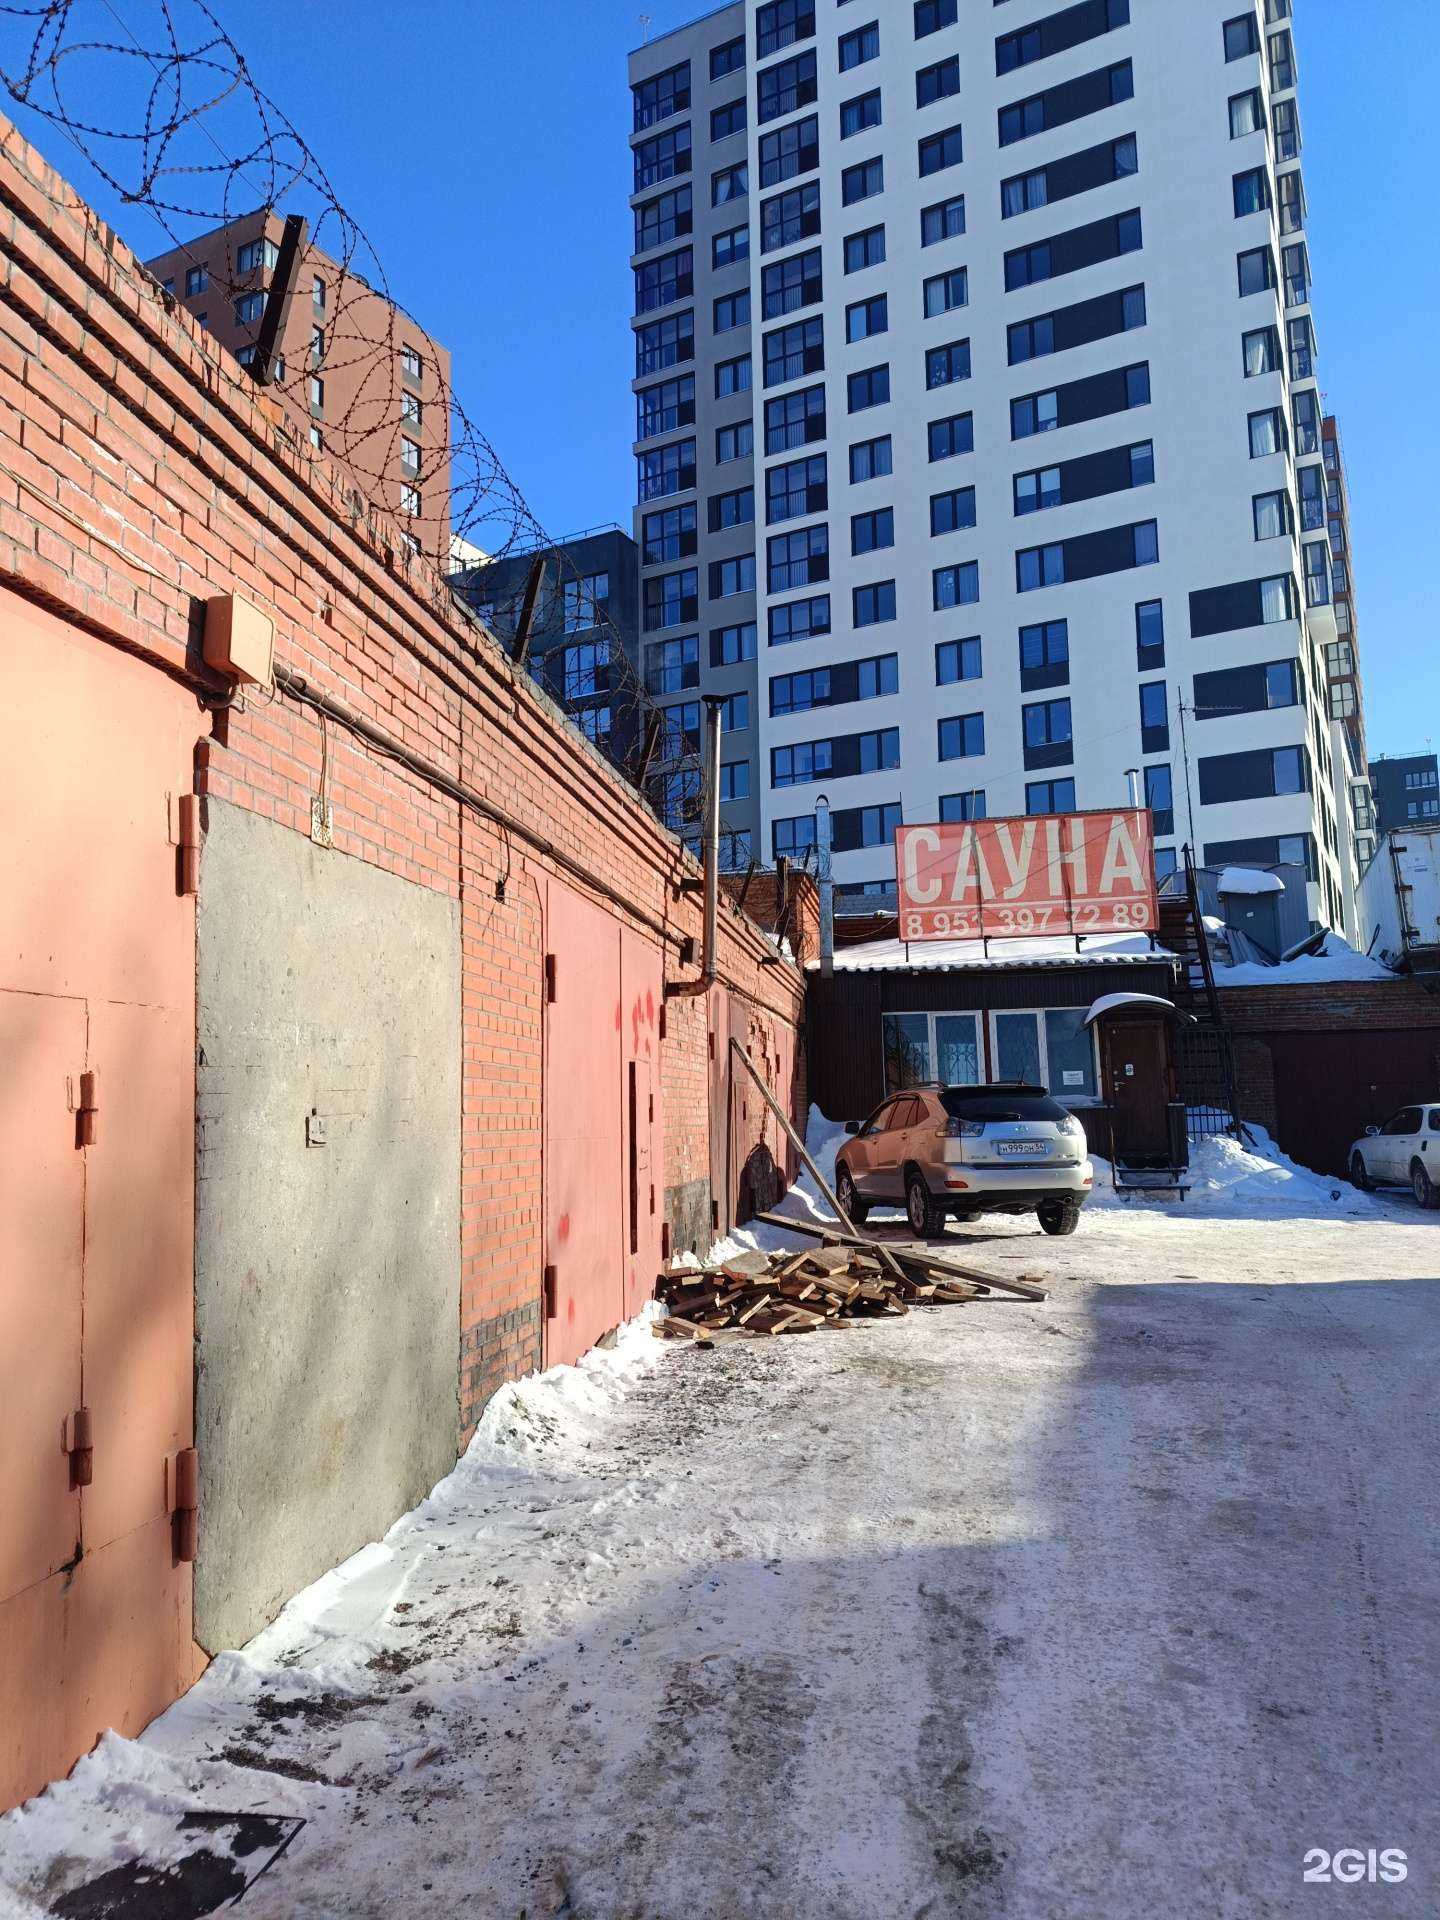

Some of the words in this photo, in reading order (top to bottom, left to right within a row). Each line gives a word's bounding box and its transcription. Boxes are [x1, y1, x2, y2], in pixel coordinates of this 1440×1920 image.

[903, 815, 1147, 904] САУНА
[906, 914, 924, 938] 8
[998, 908, 1053, 934] 397
[1063, 905, 1100, 929] 72
[1112, 902, 1149, 929] 89
